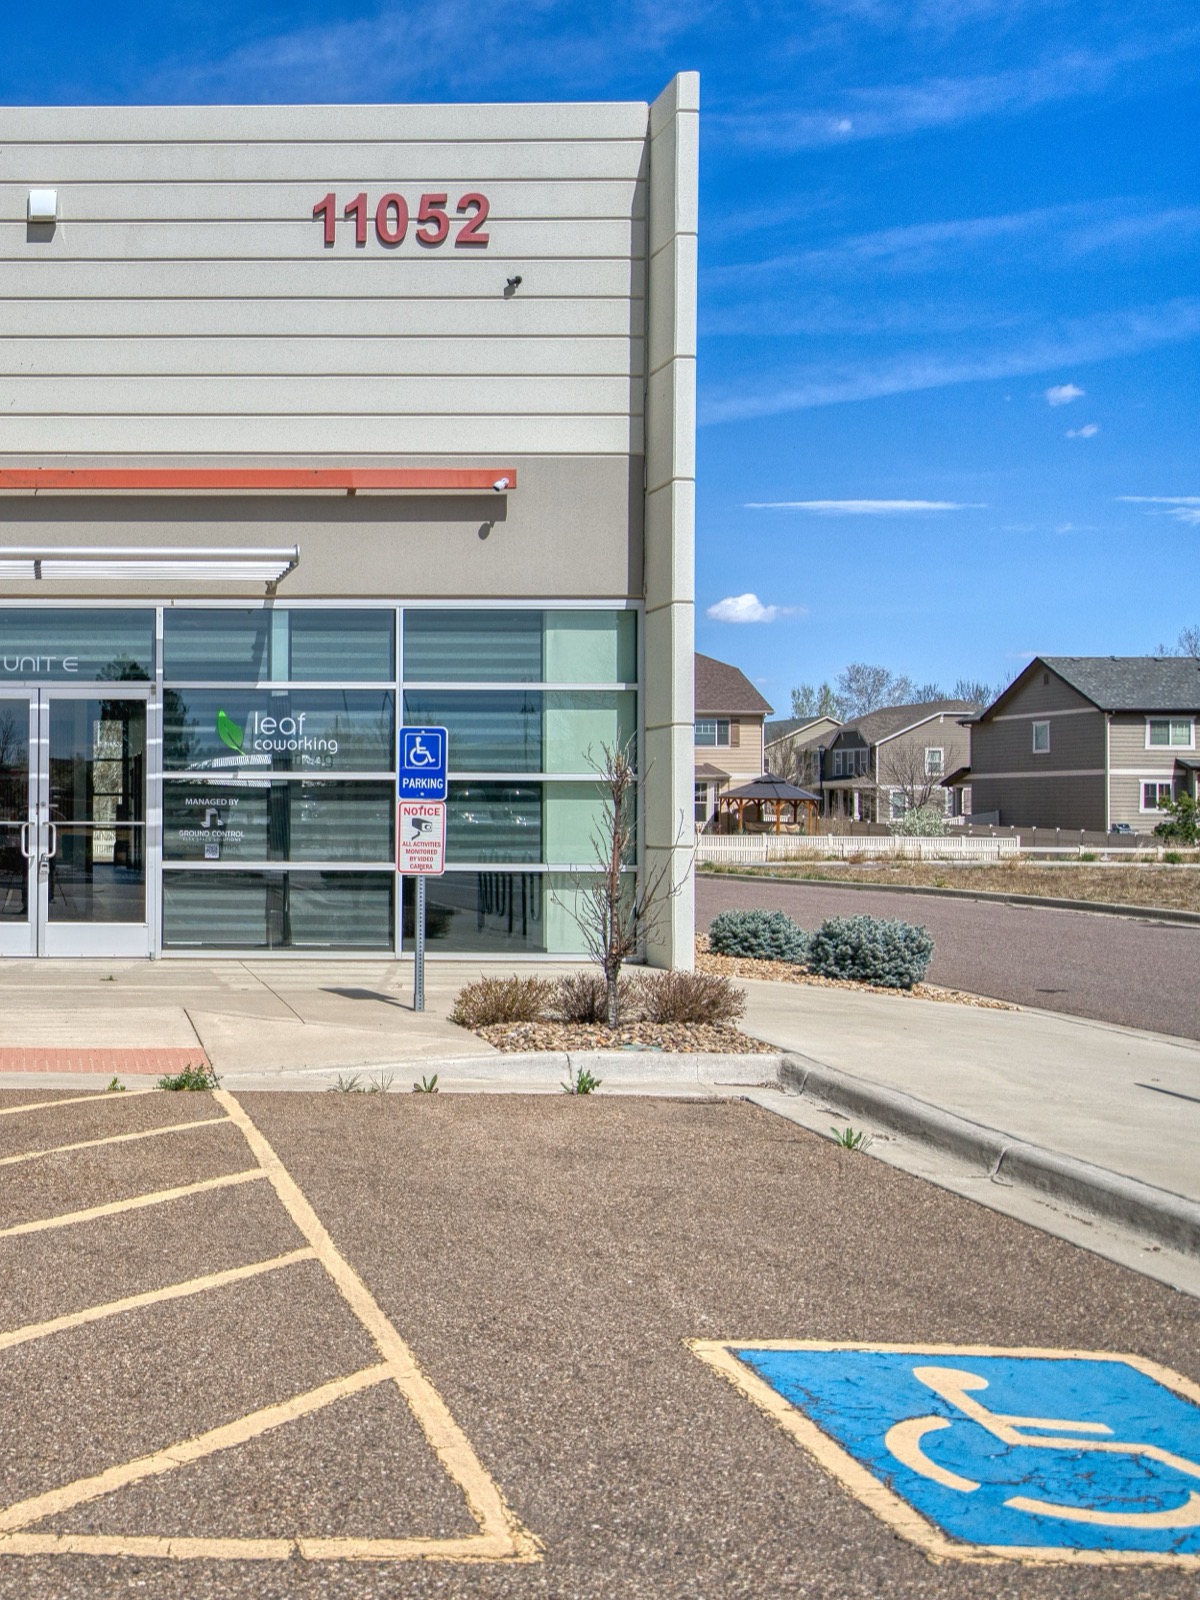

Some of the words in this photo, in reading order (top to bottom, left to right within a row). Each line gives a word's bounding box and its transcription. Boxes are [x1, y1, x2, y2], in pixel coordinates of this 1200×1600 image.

[312, 192, 491, 244] 11052
[3, 656, 57, 672] UNIT
[62, 656, 79, 672] E
[254, 711, 307, 736] leaf
[254, 736, 339, 755] coworking
[402, 777, 444, 789] PARKING
[185, 798, 227, 806] MANAGED
[228, 798, 240, 806] BY
[403, 807, 441, 817] NOTICE
[179, 829, 210, 838] GROUND
[212, 830, 246, 838] CONTROL
